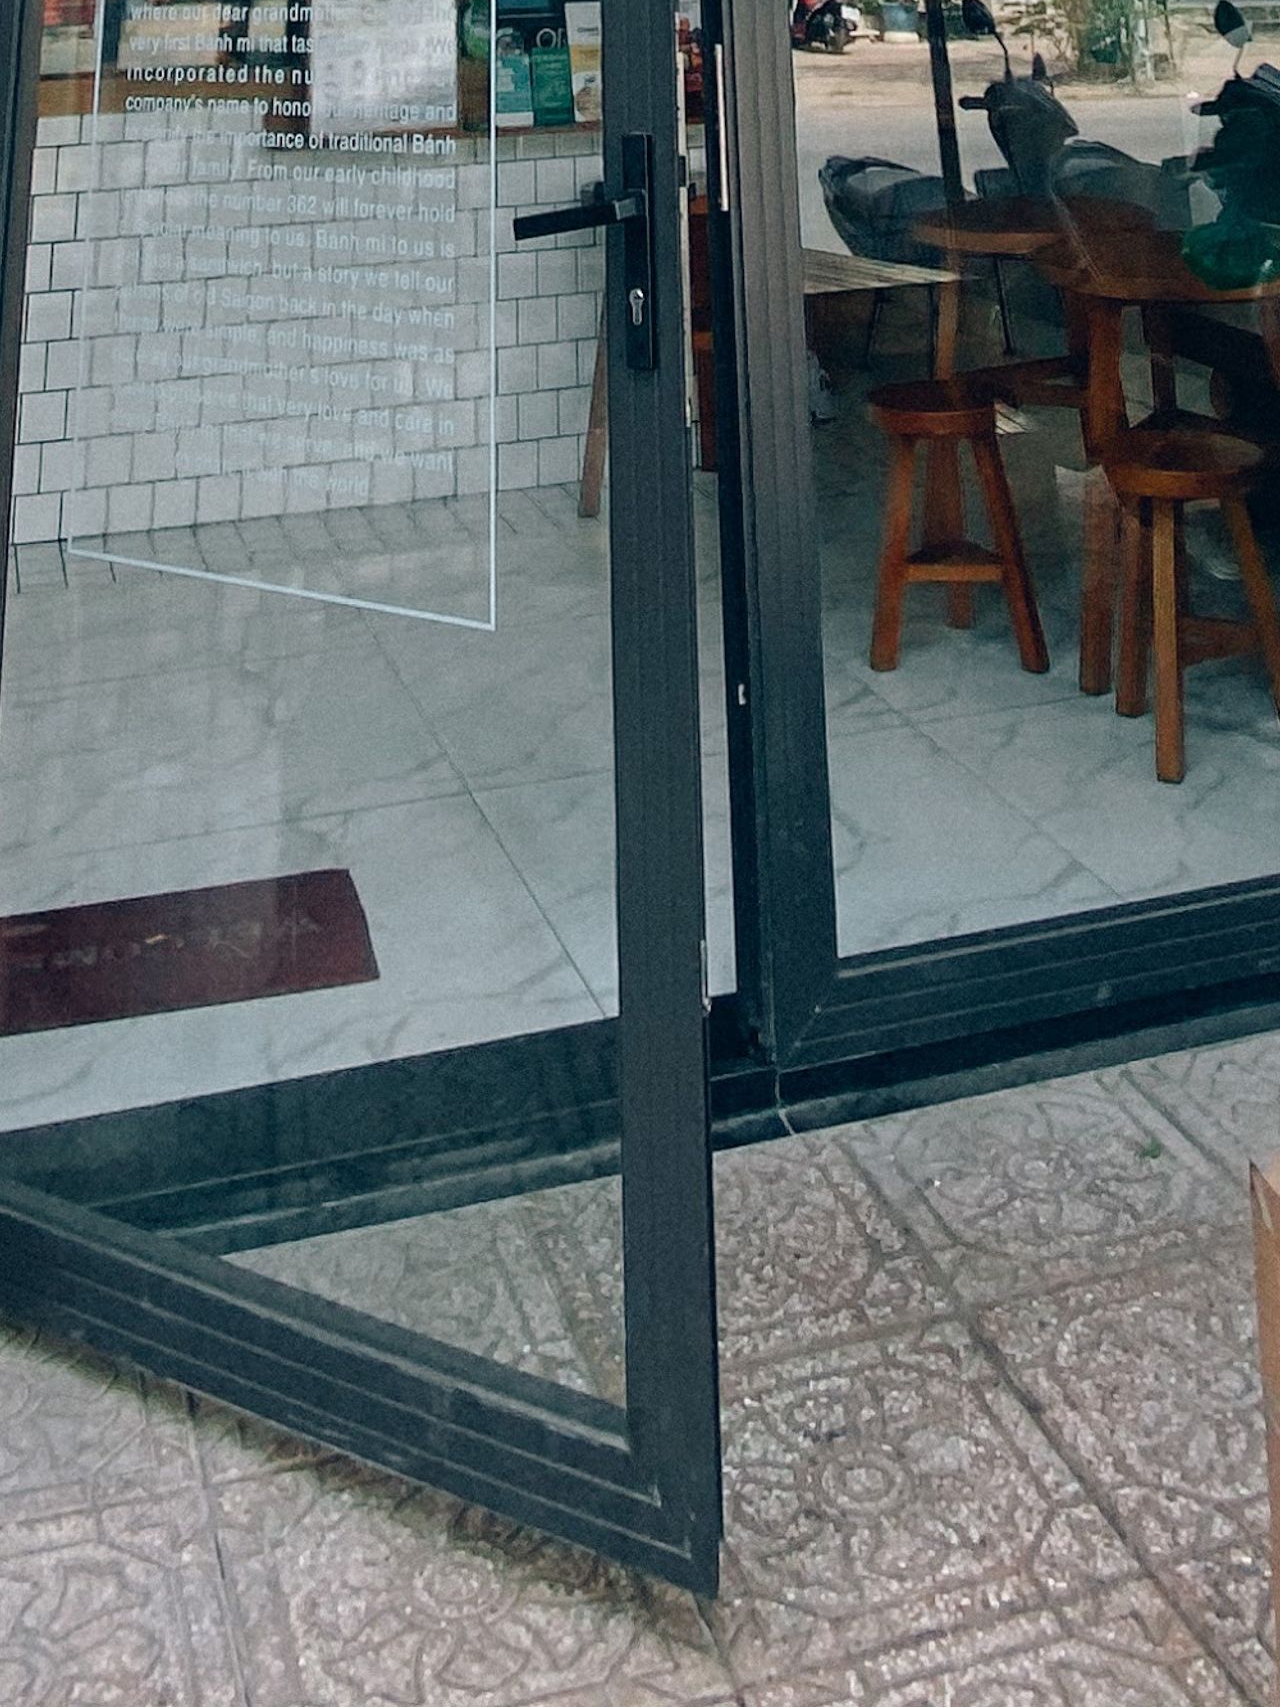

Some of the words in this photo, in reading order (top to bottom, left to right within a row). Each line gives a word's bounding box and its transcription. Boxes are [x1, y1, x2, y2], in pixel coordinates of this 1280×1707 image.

[130, 4, 177, 22] where
[213, 4, 248, 21] dear
[260, 34, 288, 54] that
[127, 64, 249, 86] incorporated
[255, 63, 285, 84] the
[126, 93, 203, 116] company's
[208, 97, 250, 114] name
[254, 96, 269, 115] to
[425, 99, 457, 122] and
[309, 130, 324, 149] of
[329, 130, 408, 153] traditional
[413, 133, 456, 155] Bánh
[248, 159, 287, 180] From
[293, 165, 319, 182] our
[325, 164, 366, 188] early
[371, 165, 456, 189] childhood
[224, 194, 281, 212] number
[287, 195, 317, 215] 362
[323, 197, 349, 217] will
[354, 198, 413, 219] forever
[418, 202, 456, 224] hold
[392, 235, 408, 255] to
[414, 239, 434, 256] us
[440, 240, 456, 258] is
[272, 258, 297, 279] but
[318, 266, 360, 291] story
[365, 270, 389, 288] we
[395, 269, 420, 291] tell
[425, 275, 456, 294] our
[280, 293, 317, 316] back
[322, 299, 336, 318] in
[342, 299, 367, 321] the
[373, 301, 402, 328] day
[409, 305, 455, 331] when
[268, 327, 297, 348] and
[303, 328, 388, 358] happiness
[395, 342, 428, 362] was
[434, 347, 455, 364] as
